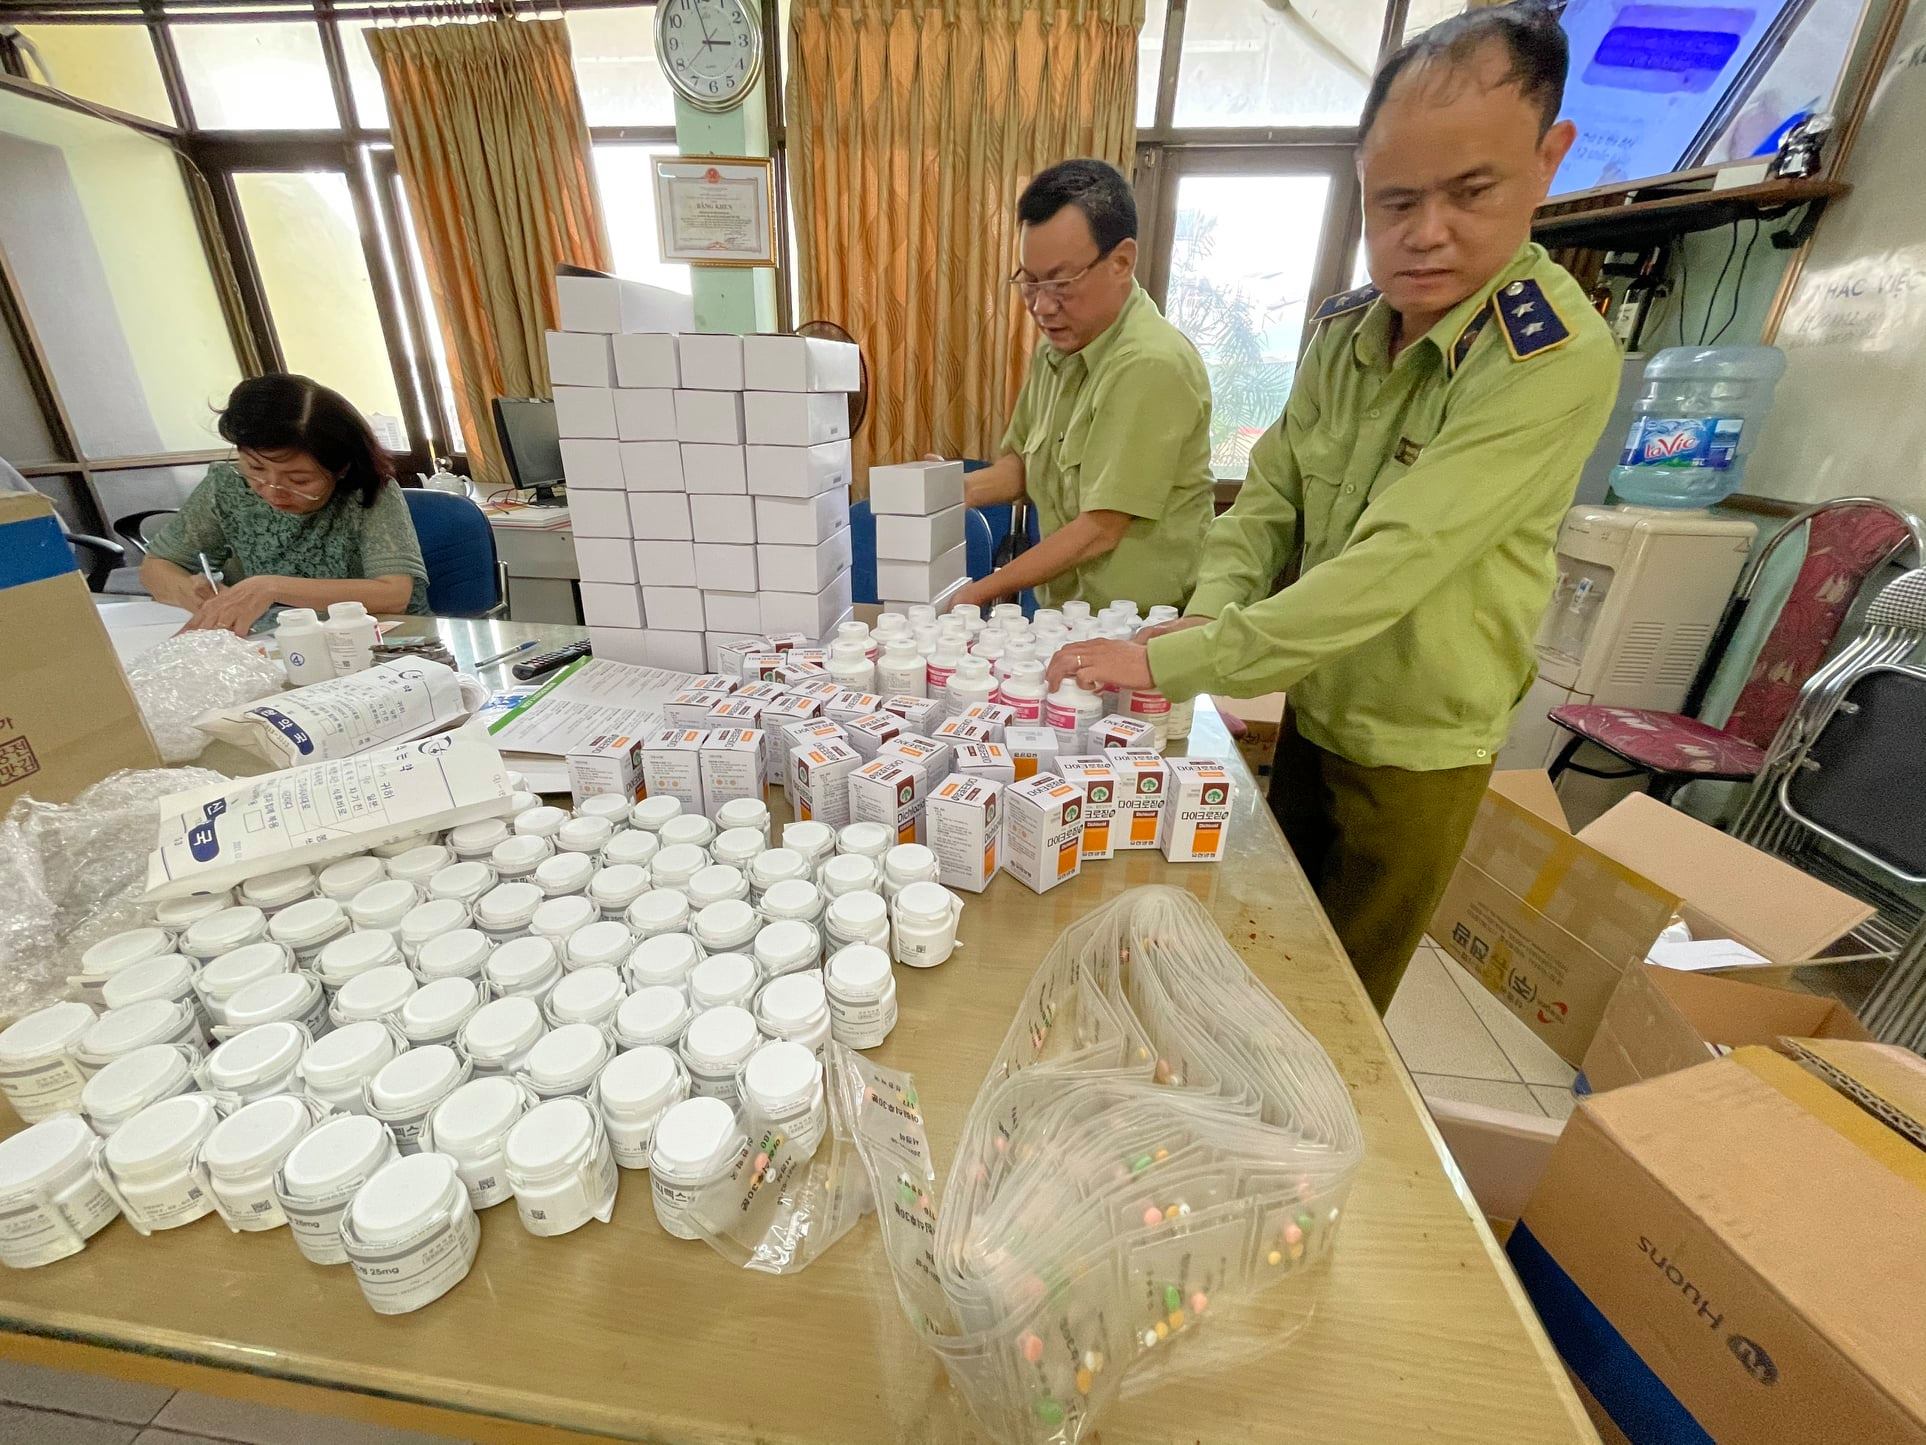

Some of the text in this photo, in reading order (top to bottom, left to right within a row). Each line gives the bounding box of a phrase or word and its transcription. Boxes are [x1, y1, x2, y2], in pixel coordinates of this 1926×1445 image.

[669, 14, 682, 28] 10
[732, 11, 741, 24] 2
[669, 38, 678, 50] 9
[739, 34, 748, 47] 3
[676, 60, 685, 71] 8
[690, 75, 699, 86] 7
[726, 76, 735, 88] 5
[709, 81, 718, 93] 6
[380, 782, 394, 799] 귀하
[370, 1266, 400, 1276] 25mg
[1637, 1236, 1724, 1330] Huons
